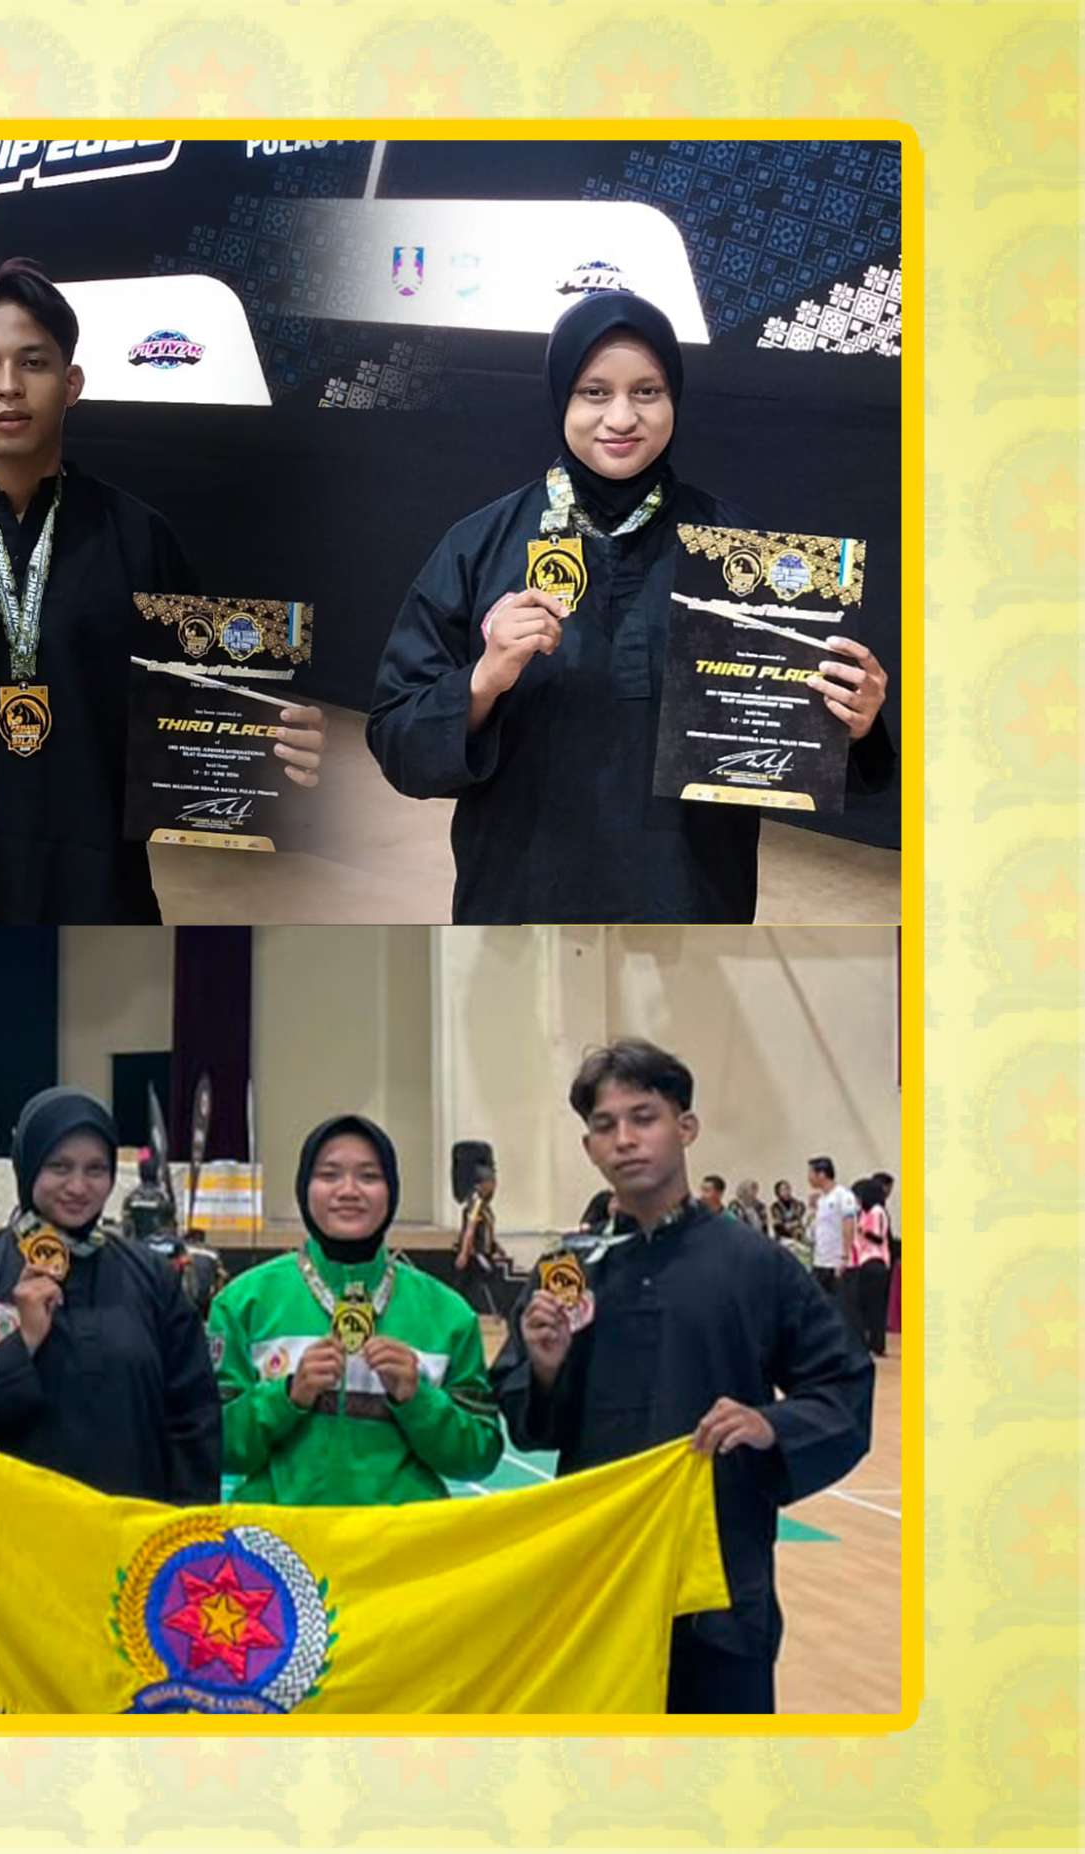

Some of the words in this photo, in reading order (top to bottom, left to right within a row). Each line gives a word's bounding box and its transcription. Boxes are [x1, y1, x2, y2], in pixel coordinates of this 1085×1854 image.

[23, 572, 38, 632] PENANG
[696, 659, 757, 678] THIRD
[157, 718, 215, 734] THIRD
[216, 722, 277, 738] PLACE
